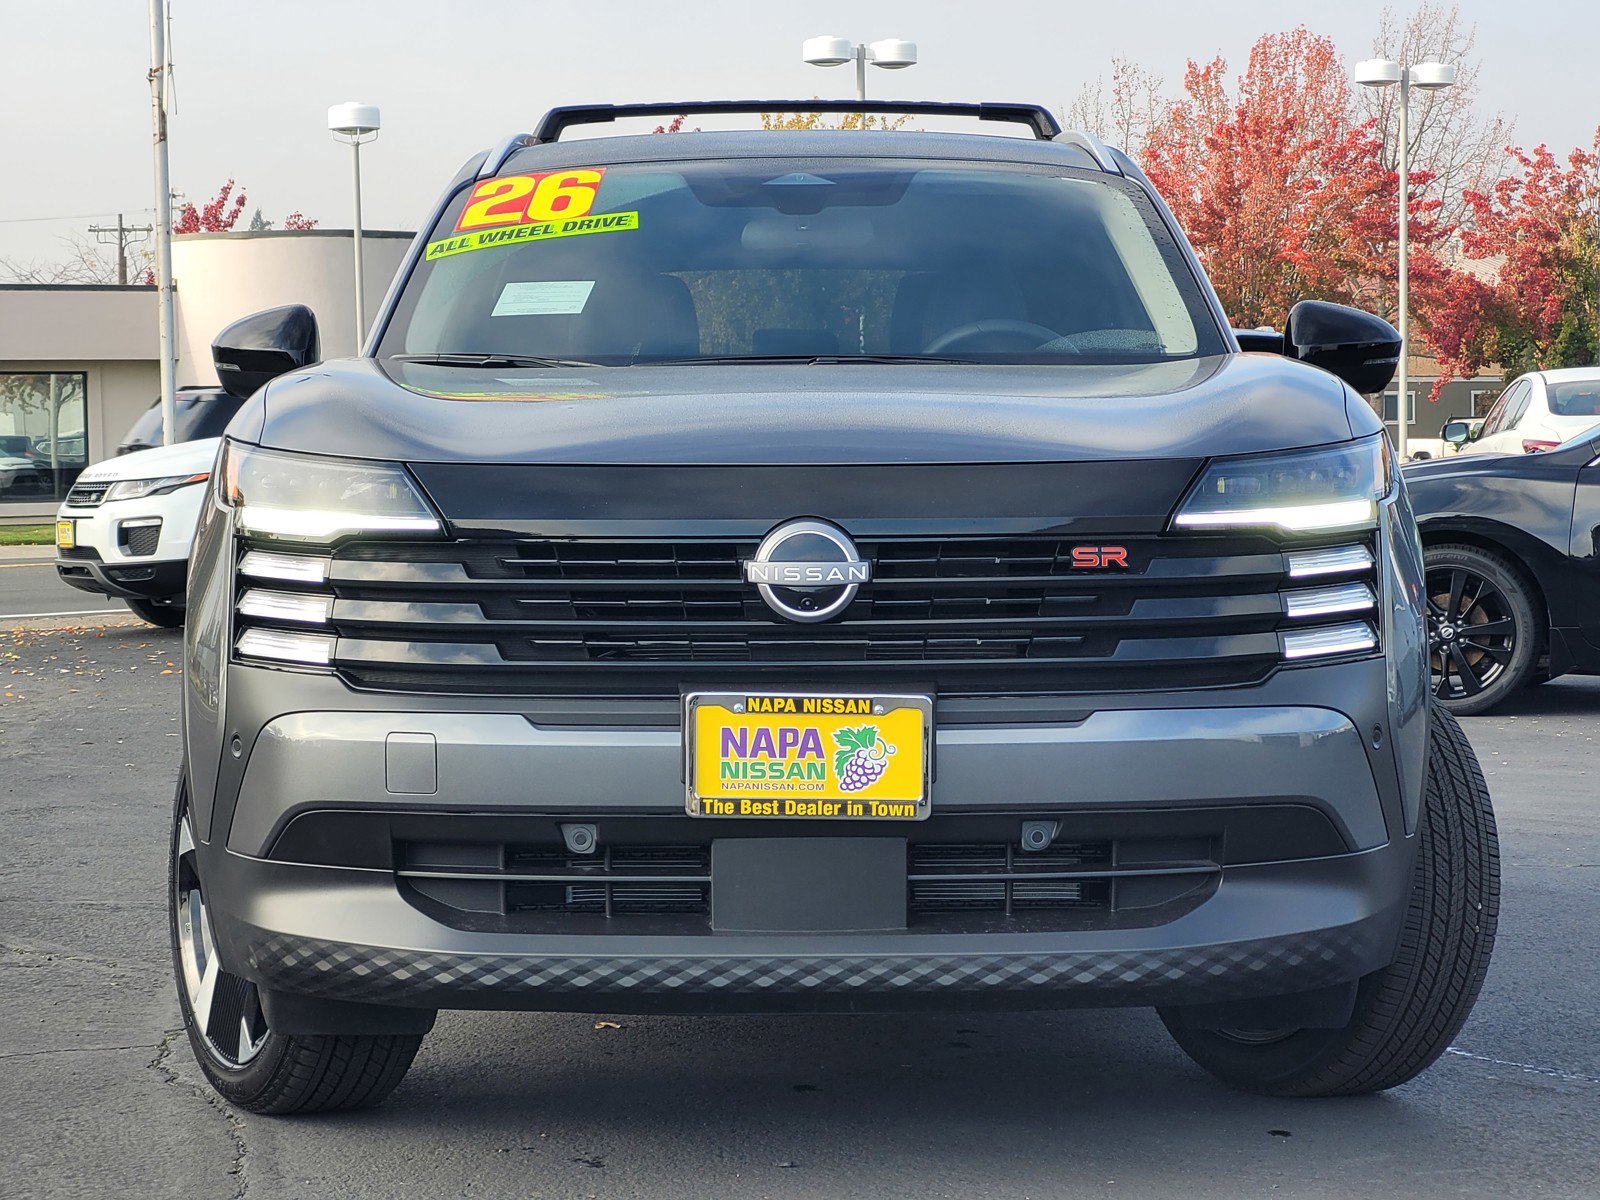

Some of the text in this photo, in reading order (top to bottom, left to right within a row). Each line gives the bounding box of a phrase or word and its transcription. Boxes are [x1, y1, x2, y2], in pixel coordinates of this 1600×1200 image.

[460, 170, 602, 229] 26
[429, 215, 632, 256] ALL WHEEL DRIVE
[1072, 546, 1128, 567] SR
[751, 565, 868, 582] NISSAN
[748, 697, 870, 714] NAPA NISSAN
[721, 727, 825, 759] NAPA
[721, 761, 826, 780] NISSAN
[721, 782, 825, 791] NAPANISSAN.COM
[703, 799, 915, 817] The Best Dealer in Town
